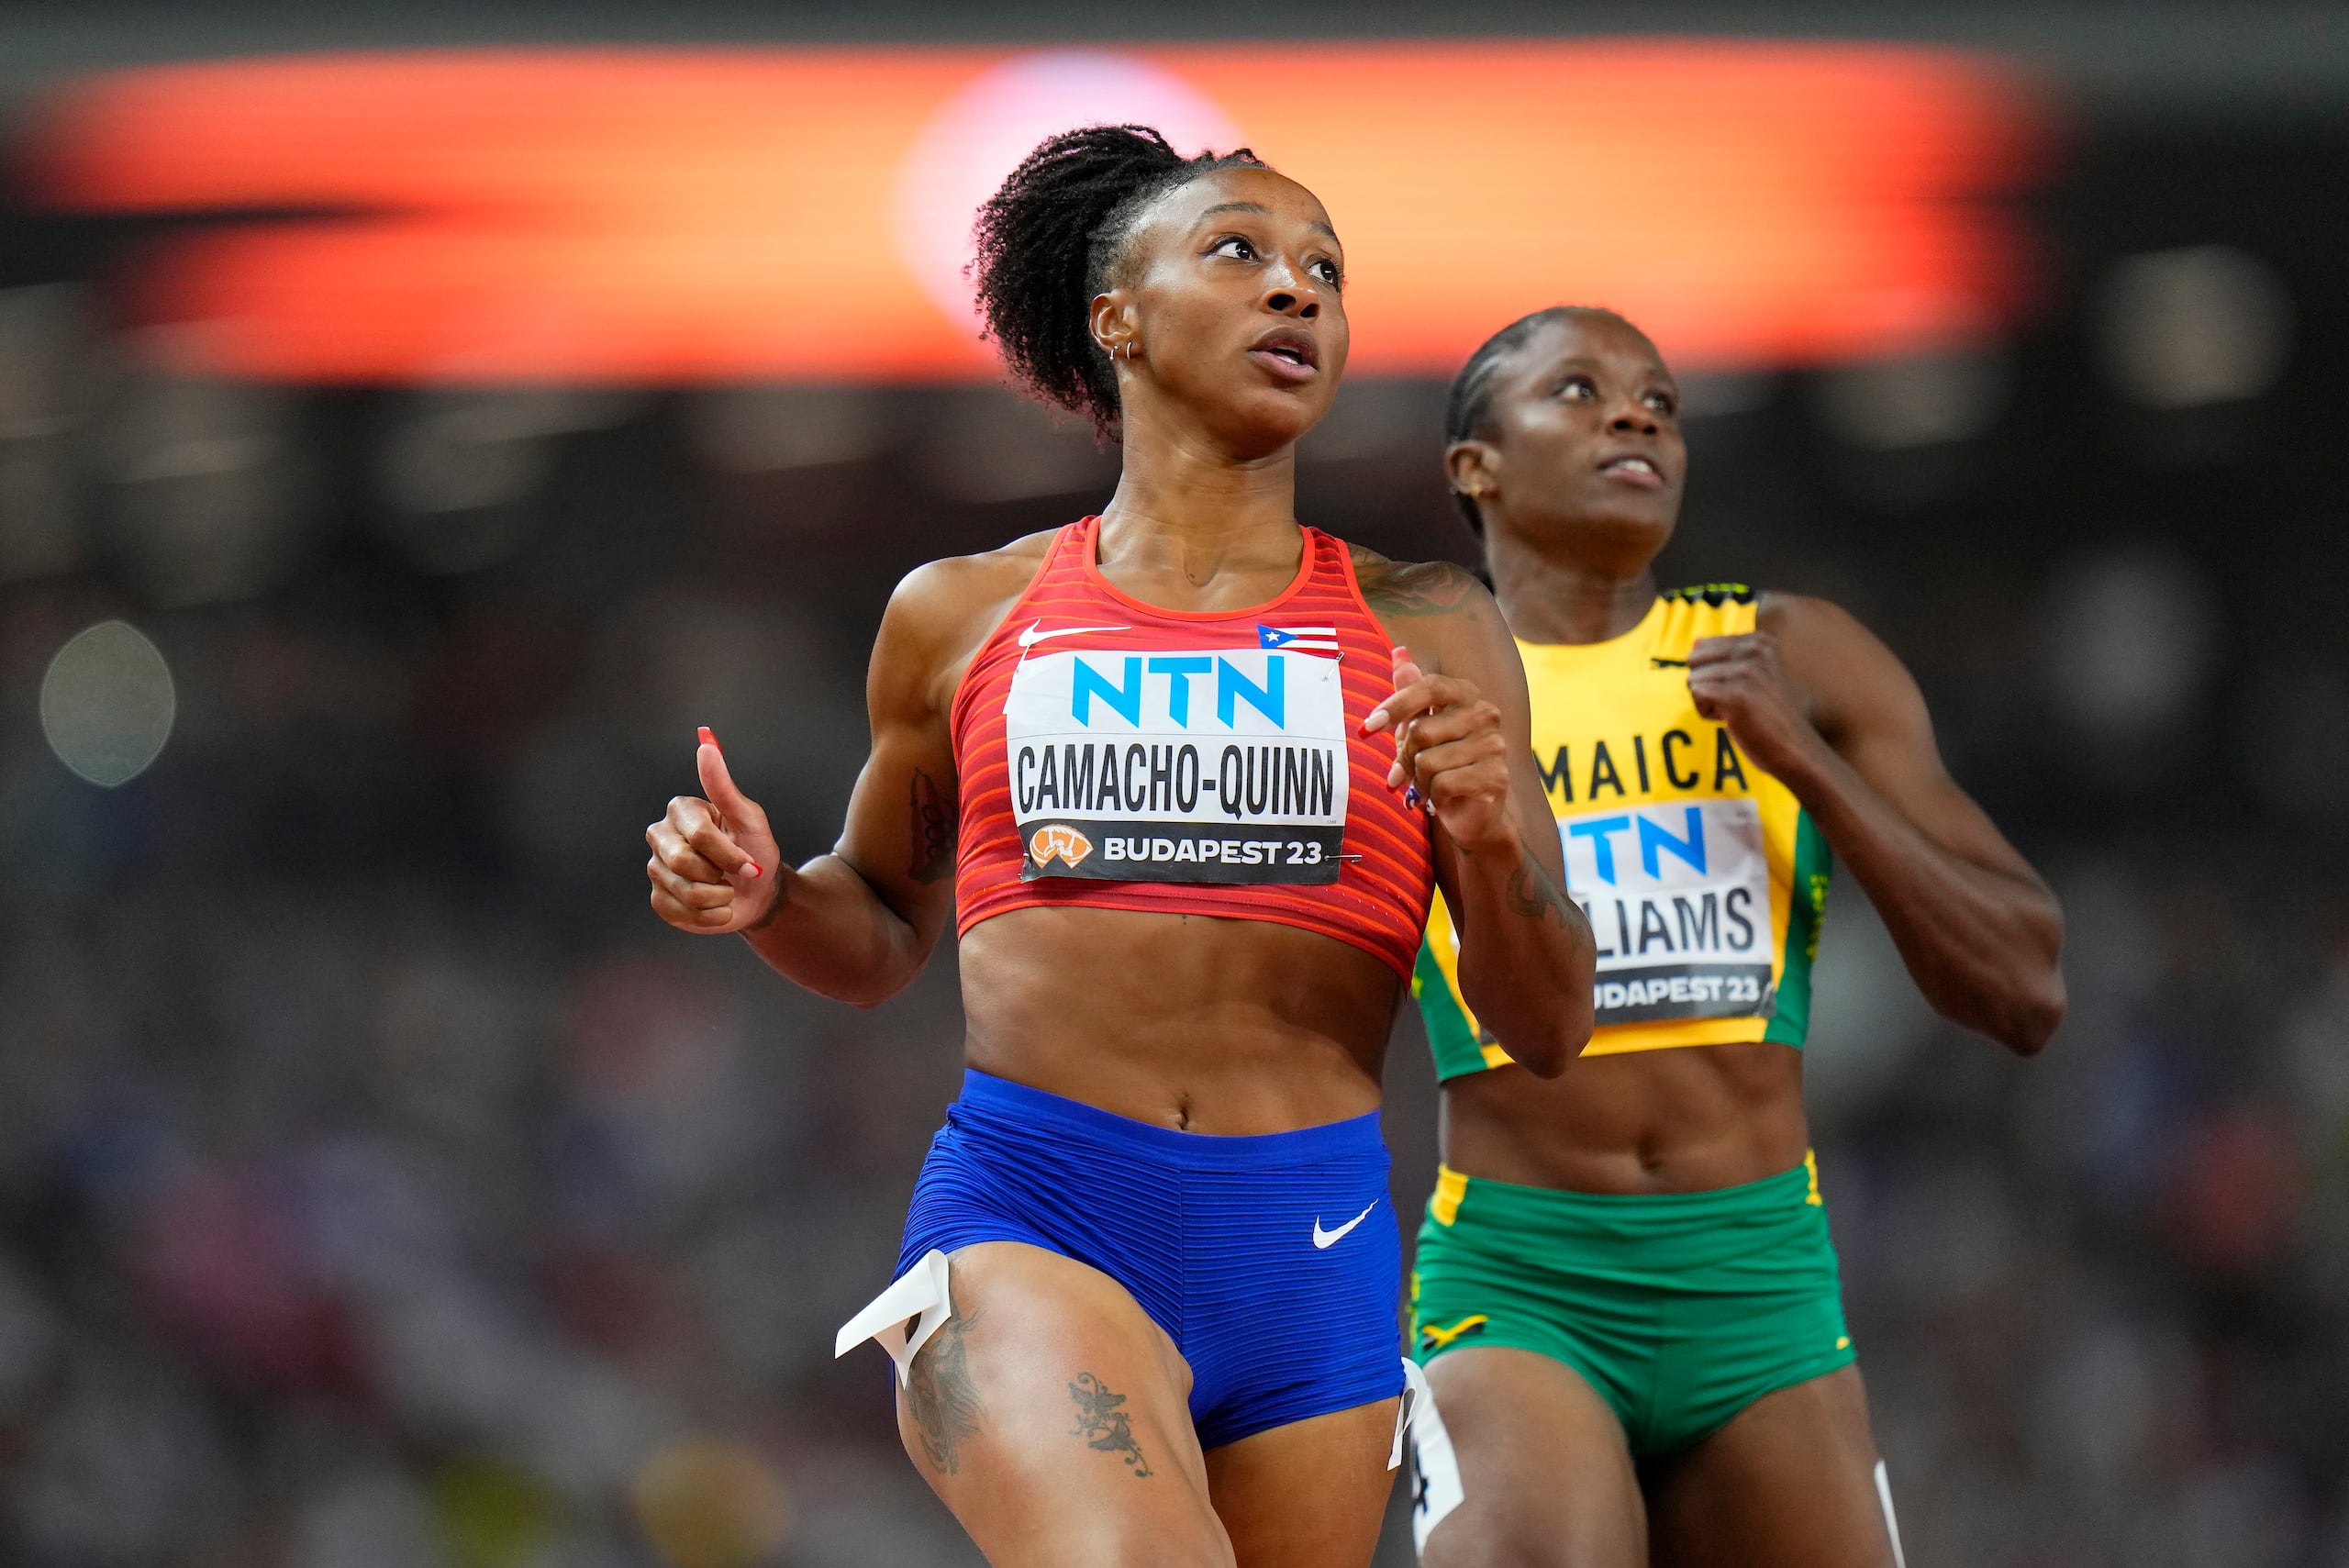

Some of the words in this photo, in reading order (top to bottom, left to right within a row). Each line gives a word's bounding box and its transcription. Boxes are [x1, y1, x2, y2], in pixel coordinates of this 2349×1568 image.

[1072, 656, 1285, 730] NTN
[1018, 743, 1333, 820] CAMACHO-QUINN
[1532, 727, 1748, 804] MAICA
[1104, 837, 1282, 865] BUDAPEST
[1286, 840, 1322, 865] 23
[1559, 806, 1707, 887] TN
[1727, 975, 1759, 1002] 23
